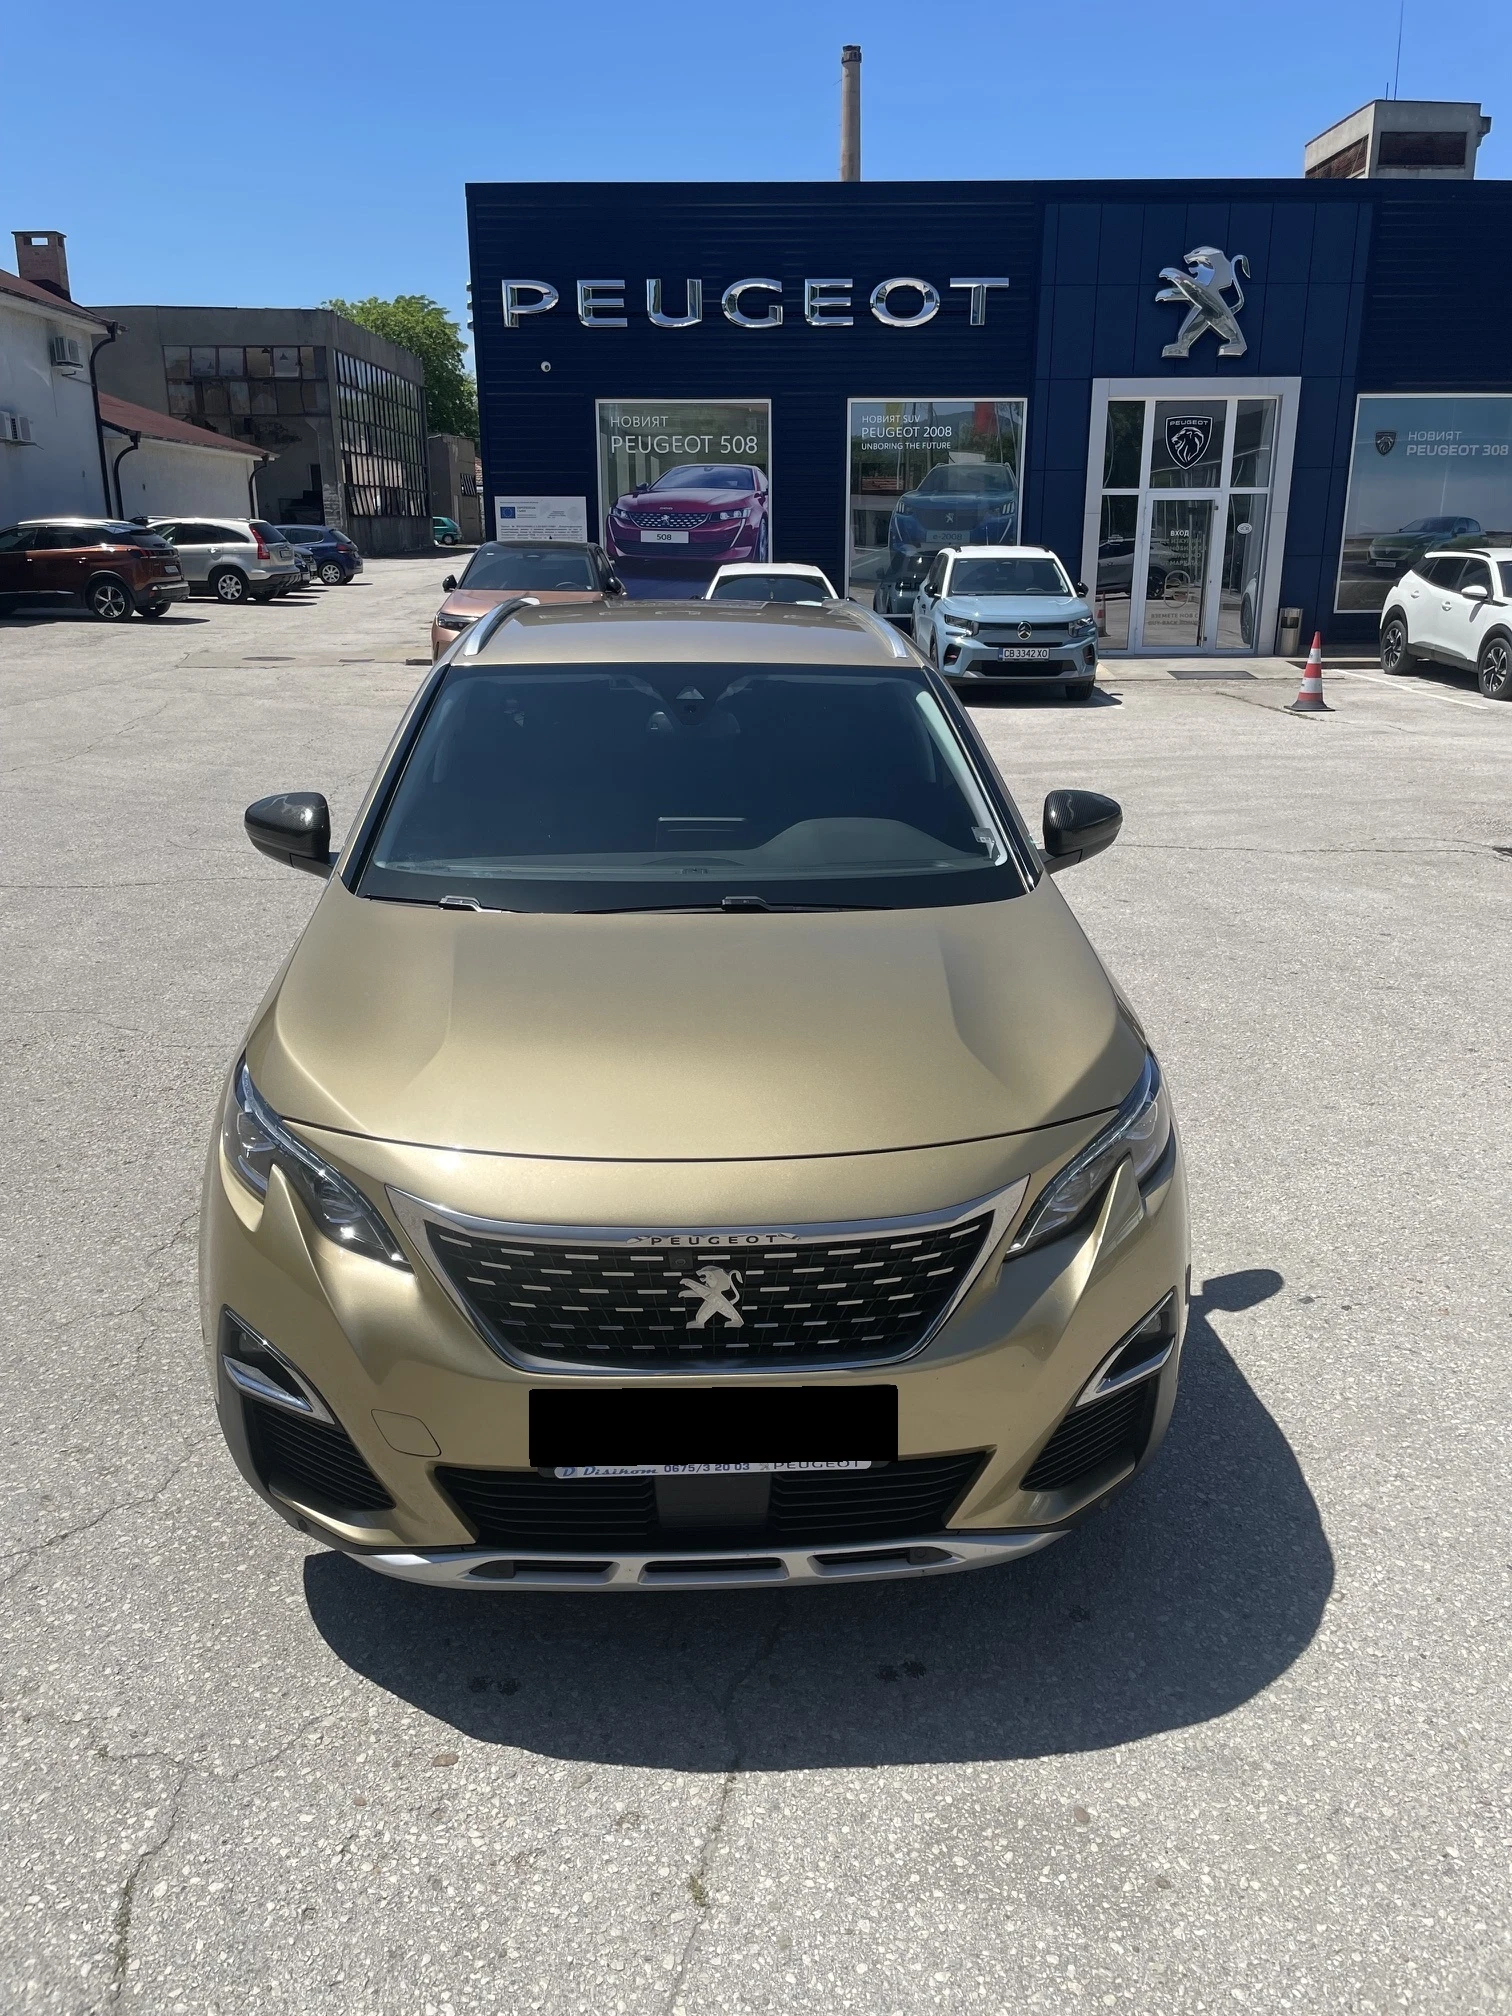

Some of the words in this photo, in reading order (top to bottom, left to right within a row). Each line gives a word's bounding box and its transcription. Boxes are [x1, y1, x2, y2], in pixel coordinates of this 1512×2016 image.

[501, 276, 1010, 329] PEUGEOT
[610, 415, 669, 428] НОВИЯТ
[861, 414, 901, 424] НОВИЯТ
[902, 414, 921, 424] SUV
[862, 426, 921, 438] PEUGEOT
[923, 426, 952, 438] 2008
[1408, 431, 1462, 441] НОВИЯТ
[611, 435, 714, 454] PEUGEOT
[720, 435, 758, 454] 508
[861, 442, 904, 450] UNBORING
[905, 442, 921, 450] THE
[922, 441, 951, 449] FUTURE
[1406, 444, 1479, 456] PEUGEOT
[1482, 444, 1509, 456] 308
[656, 533, 672, 541] 508
[1170, 529, 1190, 537] ВХОД
[1004, 649, 1015, 658] CB
[1016, 649, 1036, 658] 3342
[1037, 649, 1048, 658] XO
[651, 1234, 778, 1245] PEUGEOT
[664, 1463, 711, 1473] 0675/3
[715, 1463, 731, 1471] 20
[734, 1463, 750, 1471] 03
